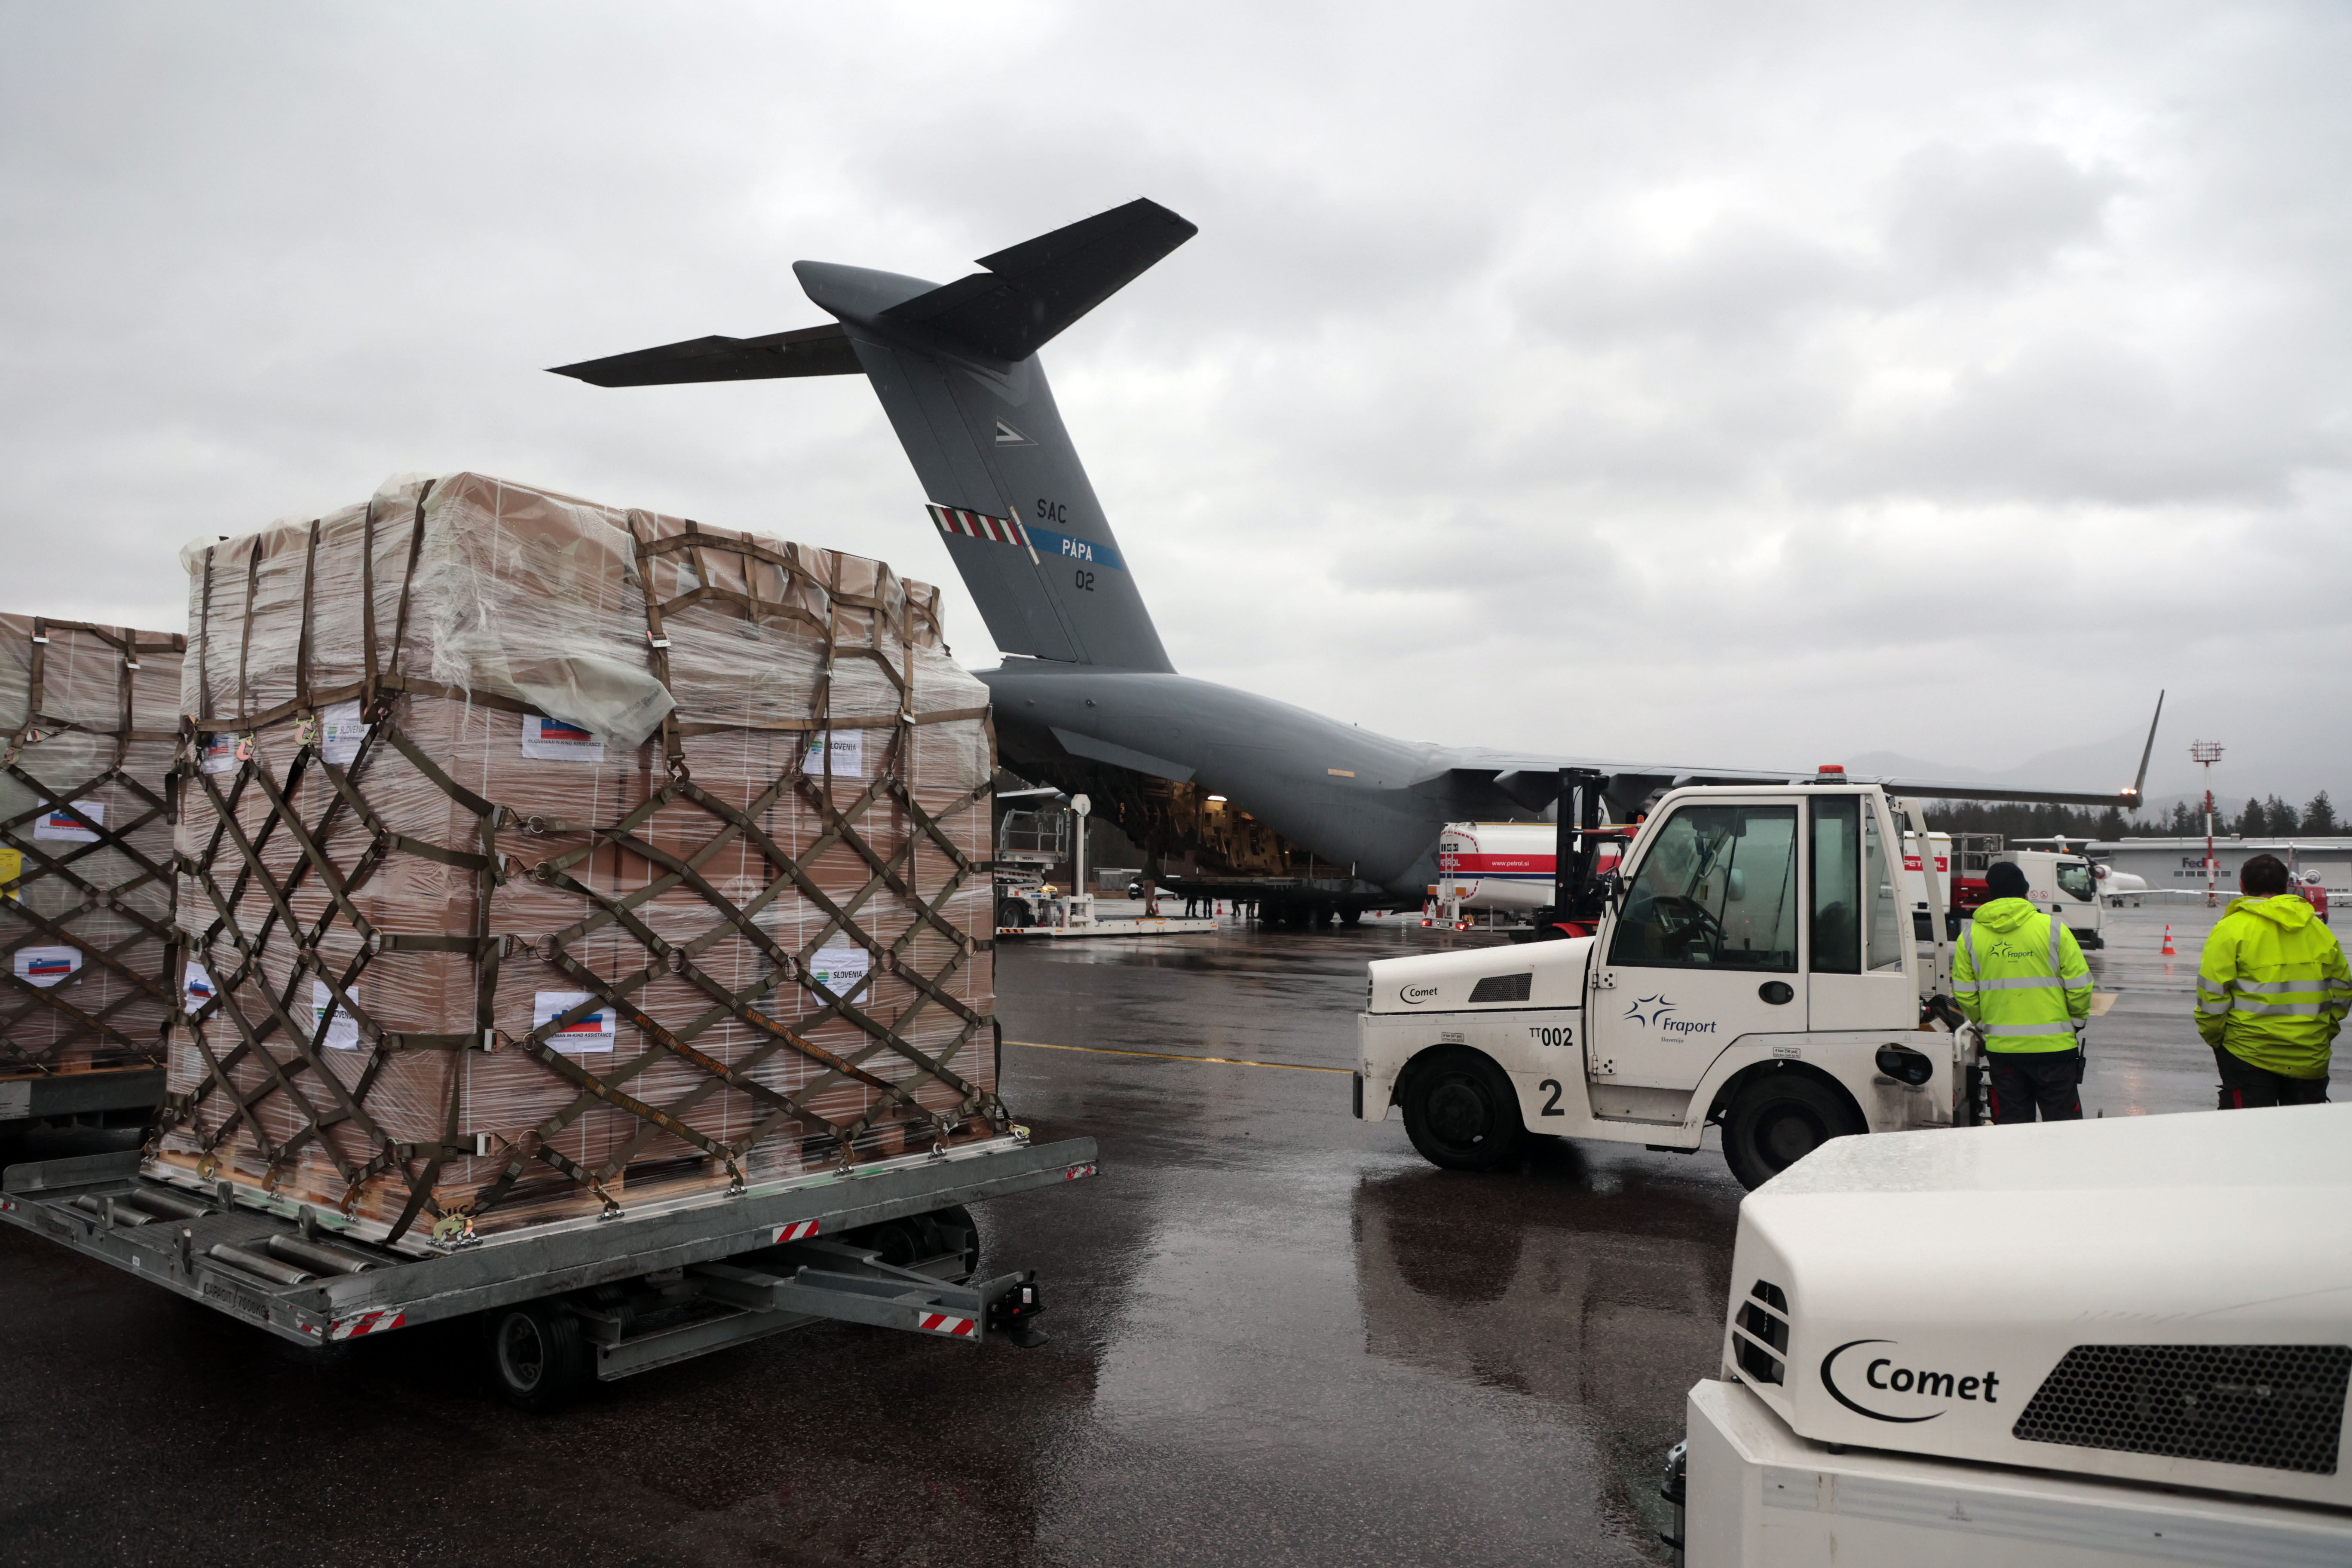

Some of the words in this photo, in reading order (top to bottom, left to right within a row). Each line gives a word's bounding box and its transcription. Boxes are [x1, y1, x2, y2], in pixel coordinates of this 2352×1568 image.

[1037, 499, 1067, 524] SAC
[1062, 538, 1092, 561] PÁPA
[1075, 570, 1095, 592] 02
[830, 742, 857, 751] LOVENIA
[1904, 860, 1945, 868] PETL
[2310, 891, 2315, 902] 6
[2007, 950, 2034, 959] Fraport
[1409, 987, 1438, 997] Comet
[334, 1010, 354, 1020] OVENIA
[1663, 1018, 1717, 1035] Fraport
[1539, 1079, 1565, 1116] 2
[203, 1283, 237, 1308] CAPACITY
[1866, 1358, 1999, 1403] Comet
